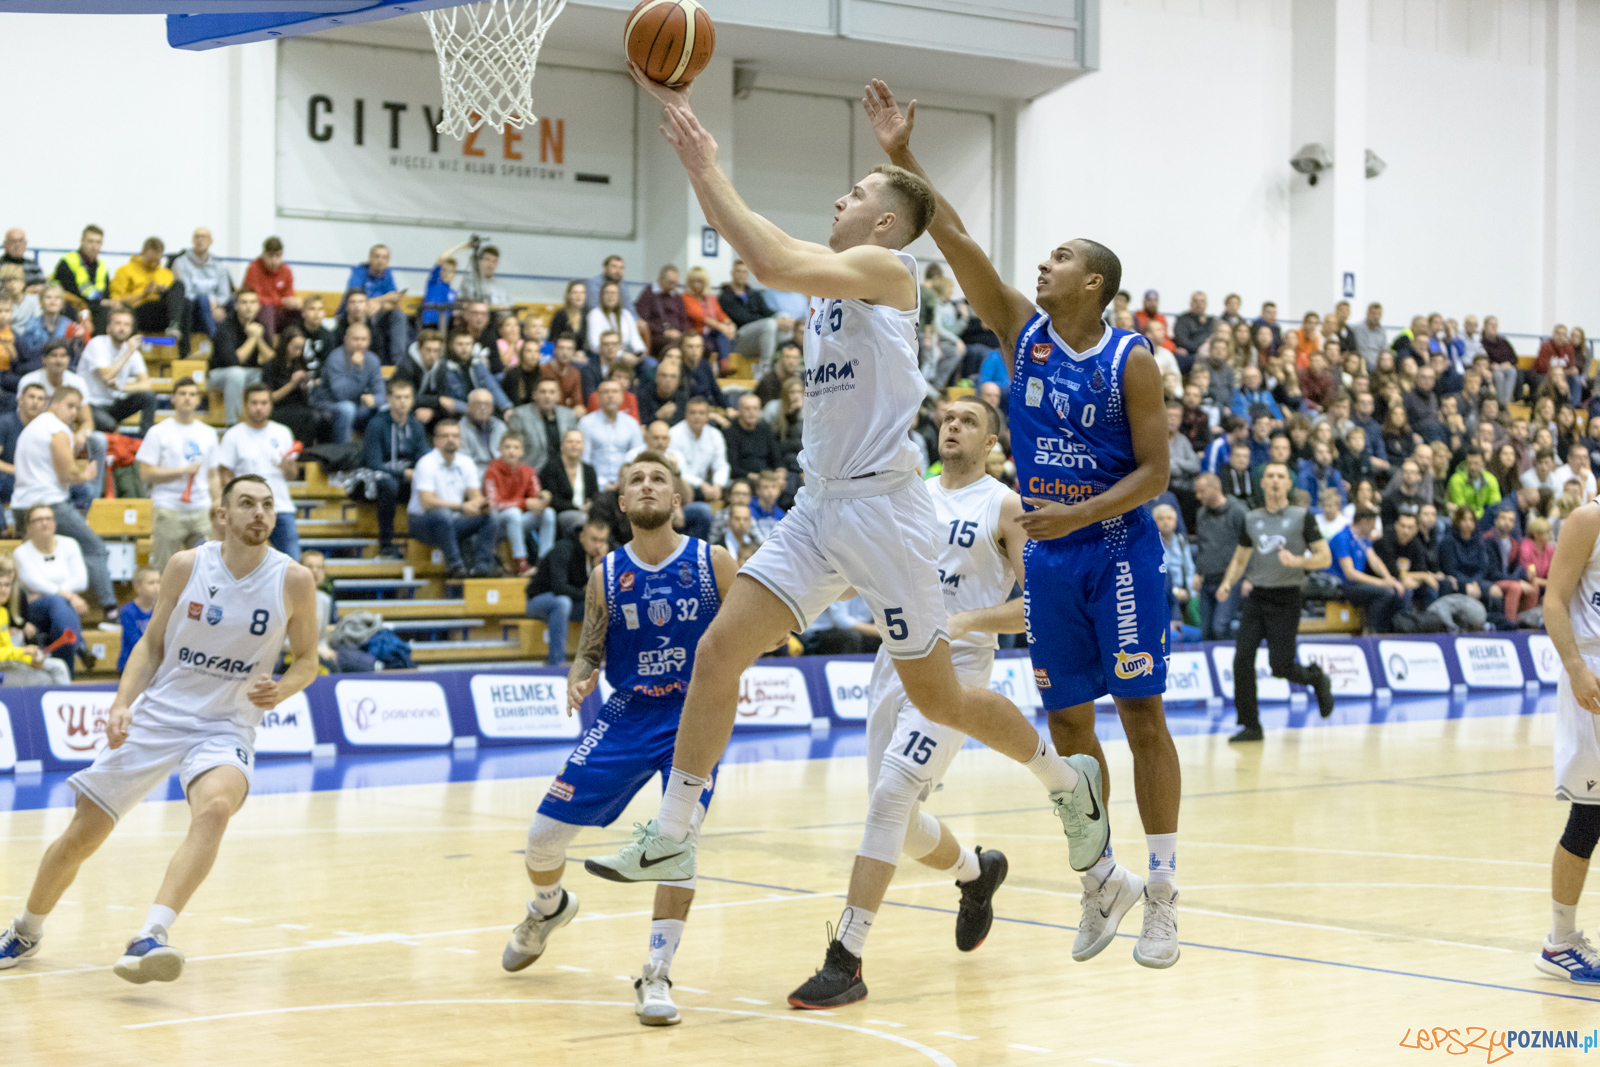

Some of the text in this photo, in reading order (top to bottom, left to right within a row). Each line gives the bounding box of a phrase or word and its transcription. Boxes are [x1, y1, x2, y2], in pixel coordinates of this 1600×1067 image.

[307, 94, 564, 164] CITYZEN
[829, 299, 842, 332] 5
[1081, 404, 1096, 427] 0
[1029, 476, 1093, 495] Cichon
[949, 519, 979, 548] 15
[676, 598, 699, 621] 32
[1115, 561, 1139, 647] PRUDNIK
[250, 609, 269, 636] 8
[884, 607, 909, 640] 5
[1122, 657, 1147, 673] LOTTO
[490, 683, 556, 703] HELMEX
[494, 704, 559, 719] EXHIBITIONS
[903, 731, 937, 765] 15
